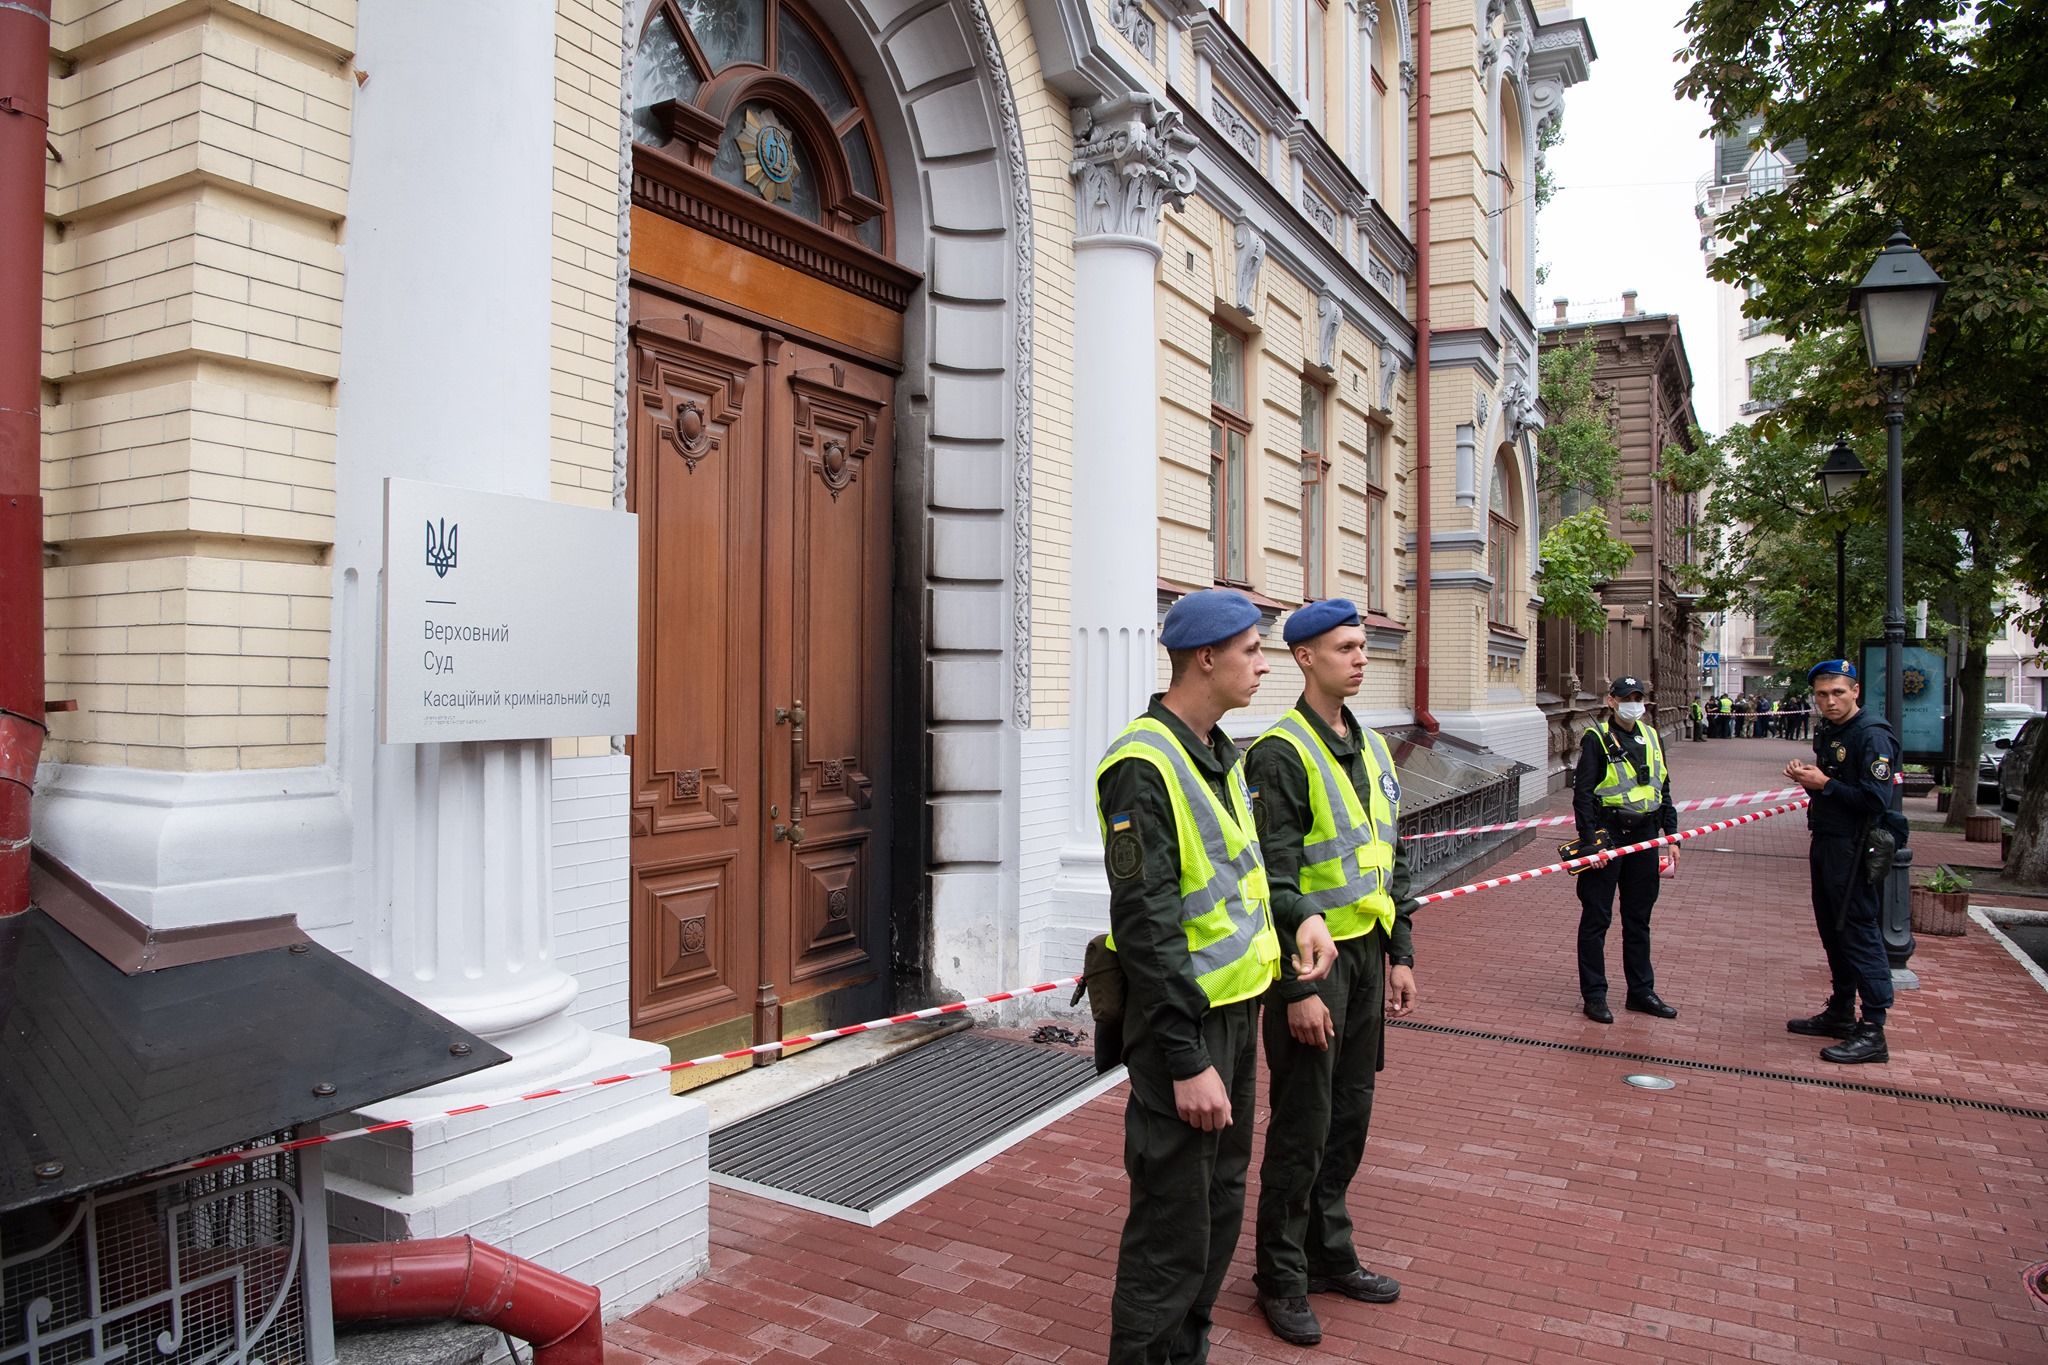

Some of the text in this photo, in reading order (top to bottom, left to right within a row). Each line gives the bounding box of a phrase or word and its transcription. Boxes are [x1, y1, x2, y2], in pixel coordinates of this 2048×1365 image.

[424, 620, 509, 645] Верховний
[424, 650, 454, 676] Суд
[423, 689, 610, 710] Касаційний кримінальний суд
